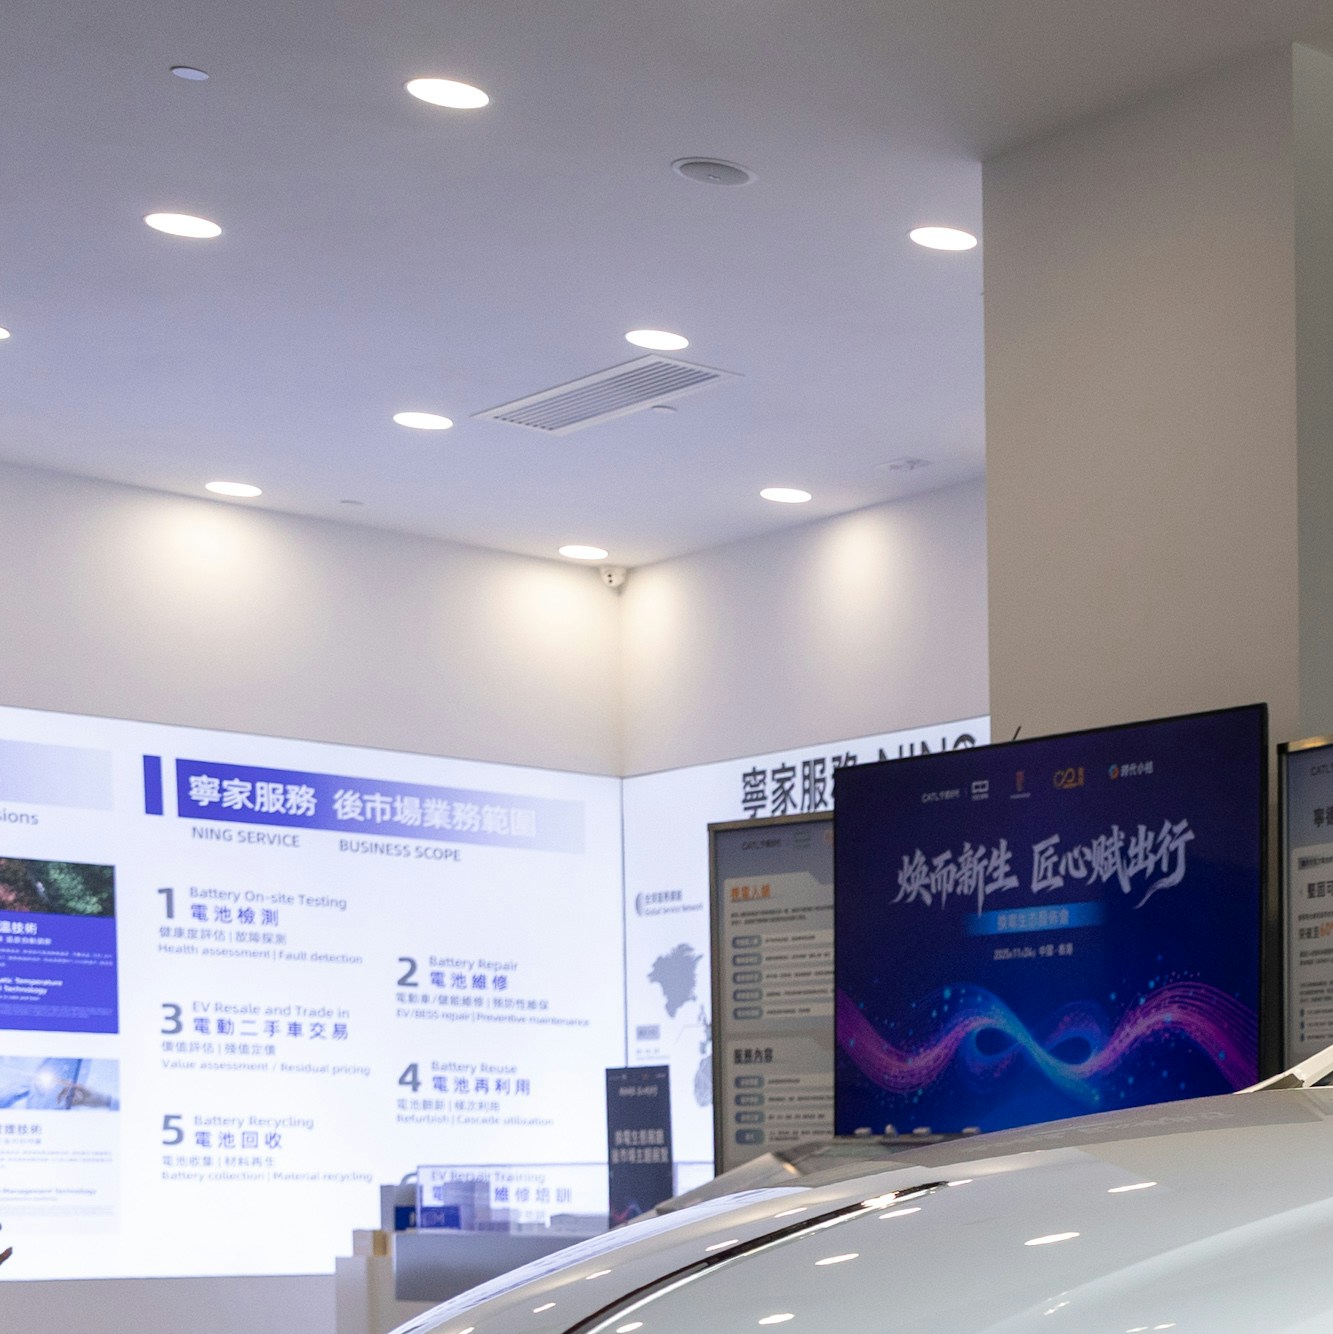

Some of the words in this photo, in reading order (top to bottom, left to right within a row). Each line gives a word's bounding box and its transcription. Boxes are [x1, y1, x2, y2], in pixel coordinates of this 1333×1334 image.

[188, 774, 318, 817] 寧家服務
[192, 826, 233, 843] NING
[237, 830, 301, 849] SERVICE
[339, 838, 411, 858] BUSINESS
[415, 844, 461, 862] SCOPE
[157, 887, 175, 920] 1
[190, 886, 241, 903] Battery
[244, 890, 295, 906] On-site
[298, 894, 348, 912] Testing
[190, 903, 280, 927] 電池檢測
[158, 943, 199, 955] Health
[202, 946, 270, 960] assessment
[310, 952, 364, 965] detection
[428, 955, 475, 972] Battery
[477, 958, 519, 973] Repair
[396, 956, 419, 988] 2
[430, 971, 509, 992] 電池維修
[160, 1003, 183, 1036] 3
[192, 1001, 210, 1013] EV
[214, 1002, 260, 1015] Resale
[264, 1004, 291, 1017] and
[296, 1005, 333, 1018] Trade
[193, 1017, 349, 1041] 電動二手車交易
[200, 1061, 268, 1072] assessment
[398, 1062, 422, 1093] 4
[431, 1060, 477, 1075] Battery
[480, 1062, 518, 1074] Reuse
[432, 1076, 531, 1096] 電池再利用
[162, 1114, 185, 1146] 5
[193, 1114, 244, 1129] Battery
[248, 1115, 315, 1130] Recycling
[195, 1131, 283, 1149] 電池回收
